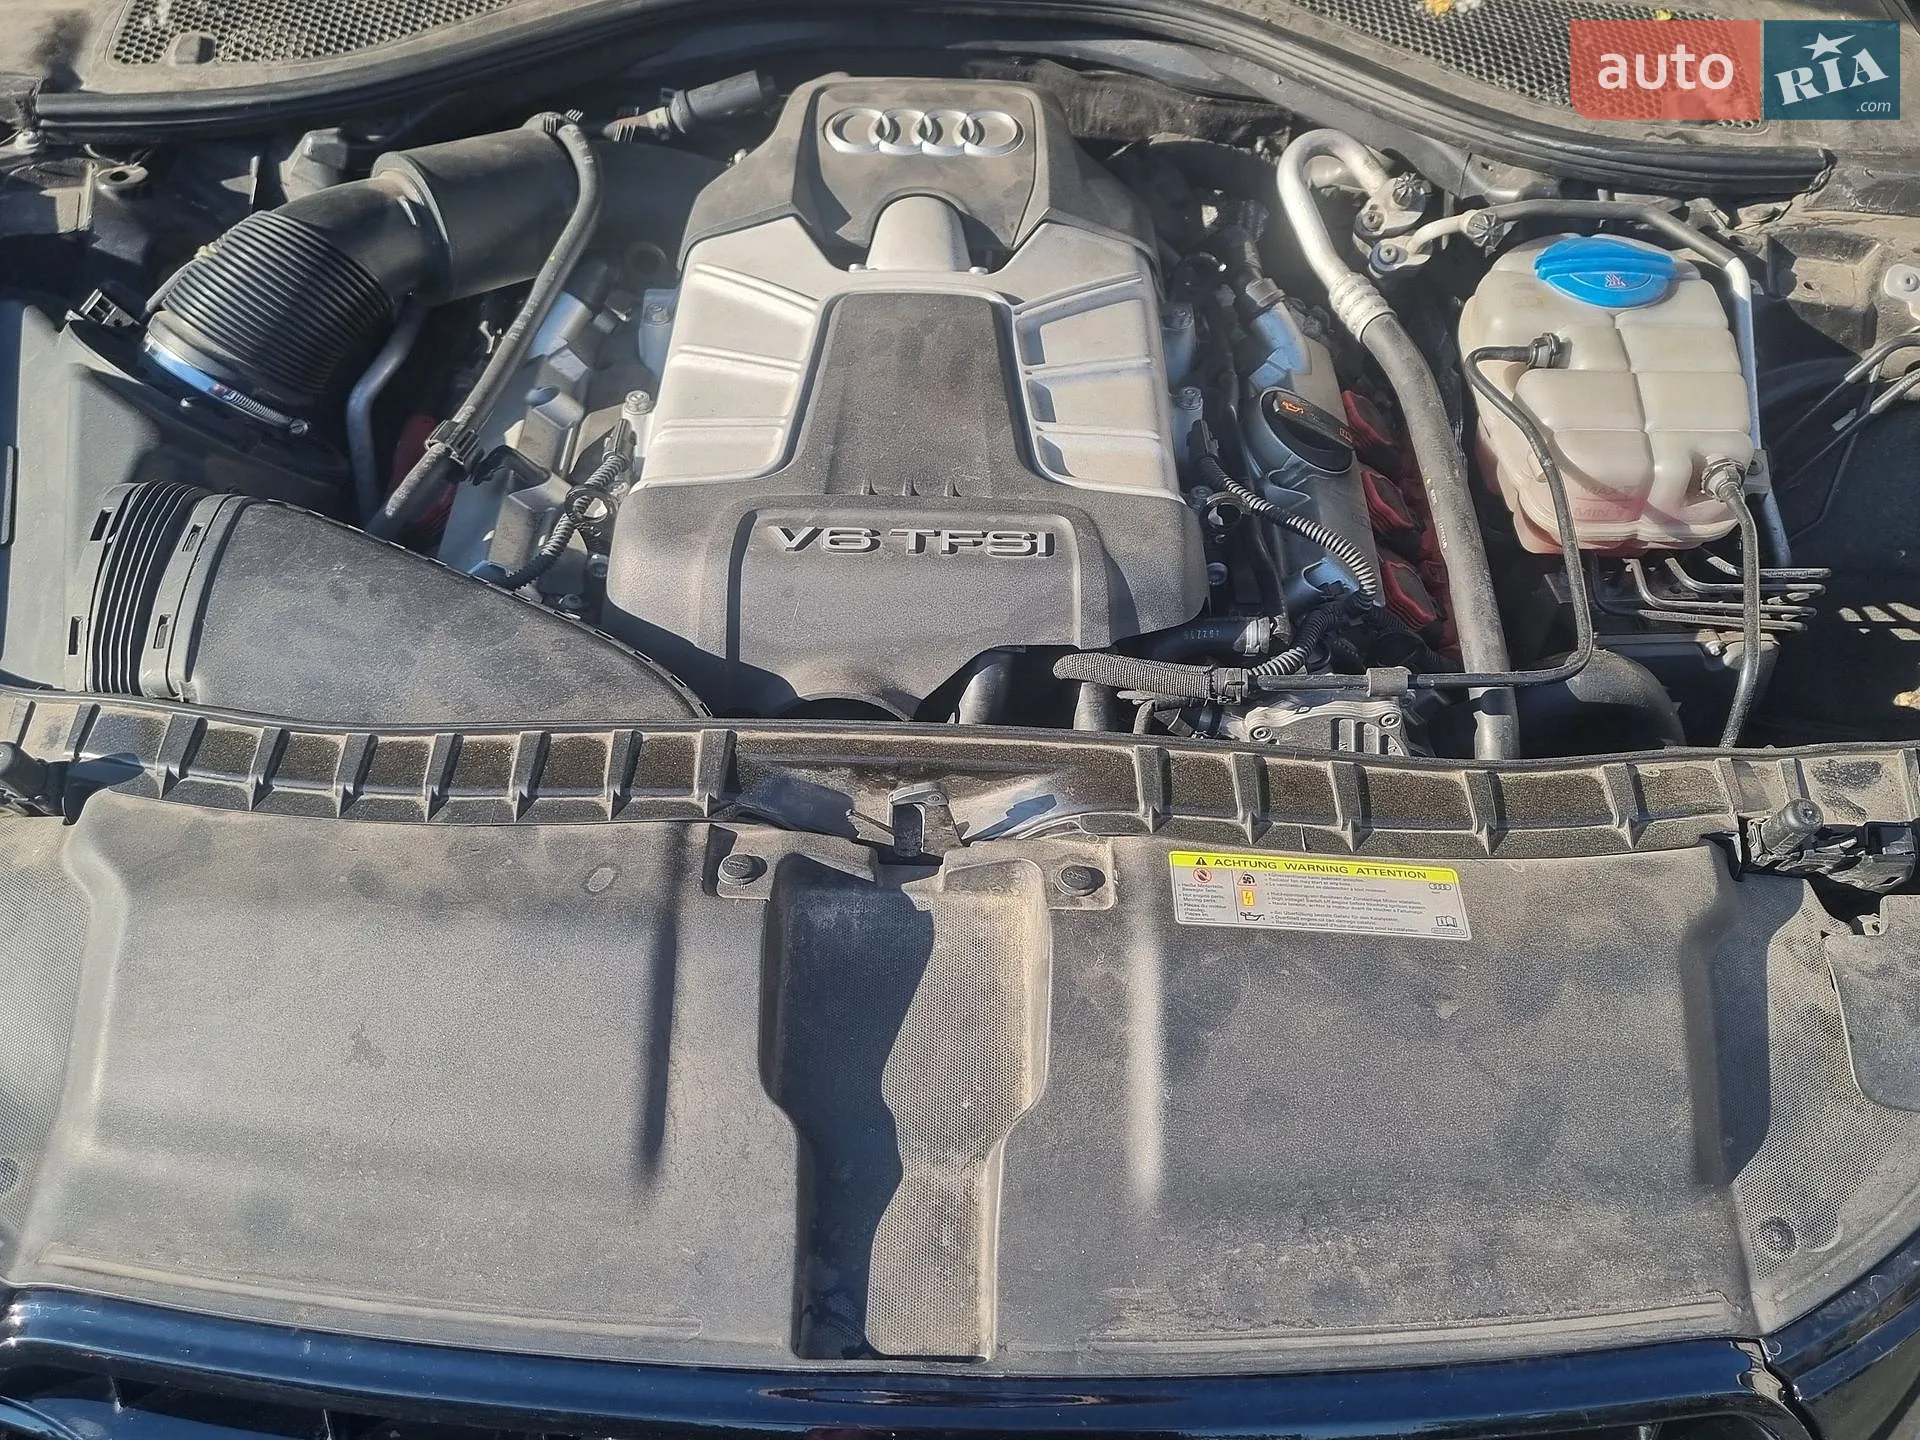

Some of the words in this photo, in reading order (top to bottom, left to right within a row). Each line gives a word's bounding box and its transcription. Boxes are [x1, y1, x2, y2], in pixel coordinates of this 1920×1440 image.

[768, 525, 880, 554] V6
[888, 527, 1055, 557] TFSI
[1214, 858, 1278, 870] ACHTUNG
[1284, 862, 1349, 875] WARNING
[1356, 867, 1427, 880] ATTENTION
